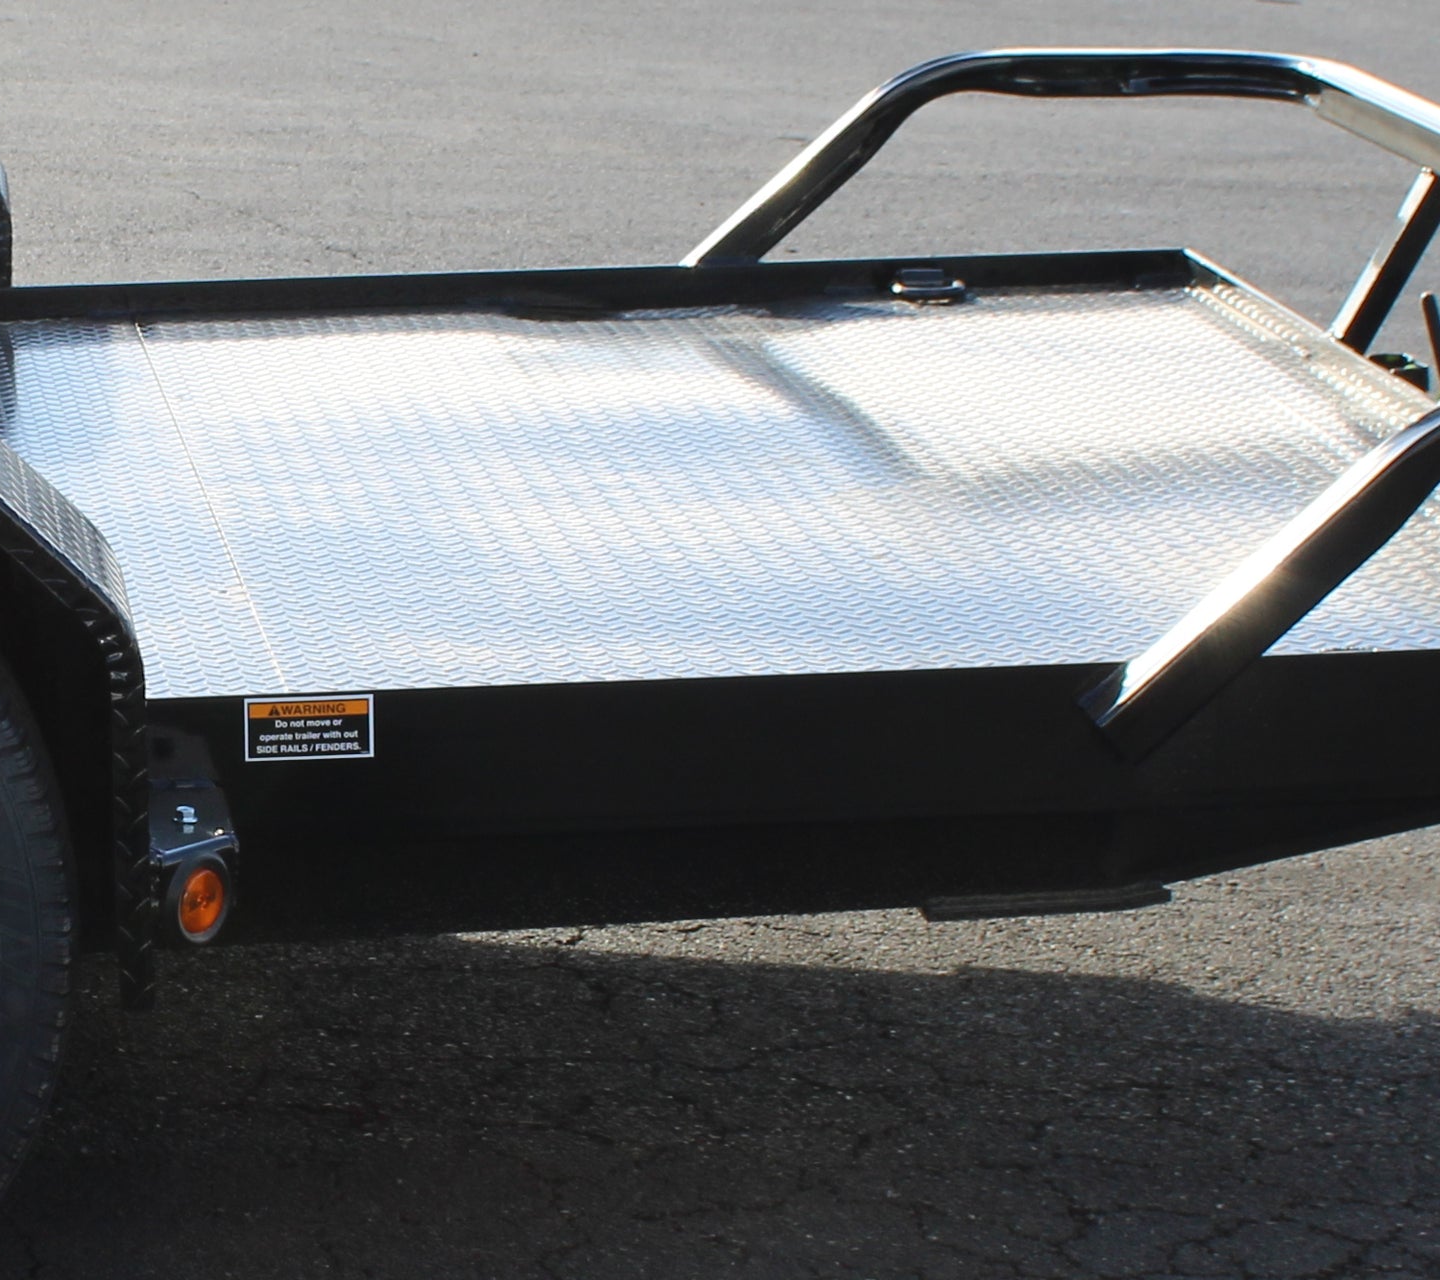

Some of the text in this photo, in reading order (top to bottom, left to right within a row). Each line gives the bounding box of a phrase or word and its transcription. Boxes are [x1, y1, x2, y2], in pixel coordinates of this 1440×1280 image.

[281, 703, 346, 716] WARNING
[275, 719, 343, 728] Do not move or
[259, 730, 359, 742] operate trailer with out
[256, 745, 278, 754] SIDE
[280, 744, 309, 753] RAILS
[315, 742, 362, 752] FENDERS.
